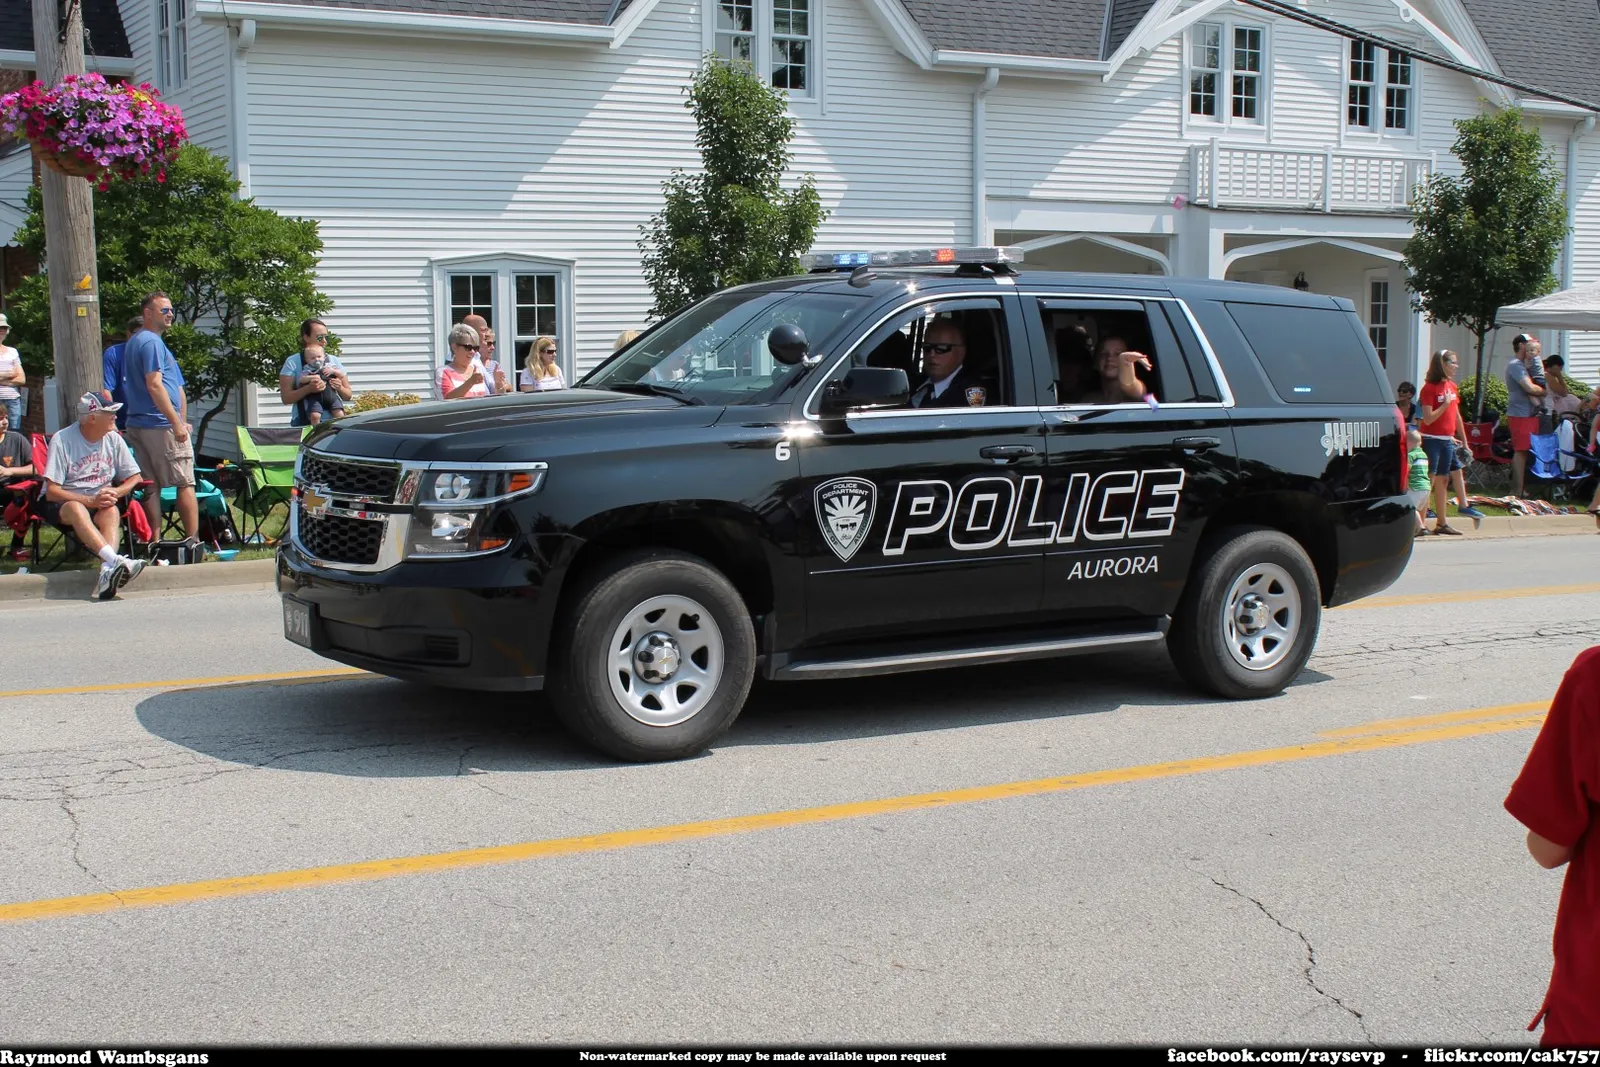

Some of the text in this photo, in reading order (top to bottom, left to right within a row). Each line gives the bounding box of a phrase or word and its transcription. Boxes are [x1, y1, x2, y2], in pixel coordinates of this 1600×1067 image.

[775, 441, 791, 461] 6
[822, 489, 869, 499] DEPARTMENT
[882, 467, 1186, 556] POLICE
[1066, 554, 1160, 581] AURORA
